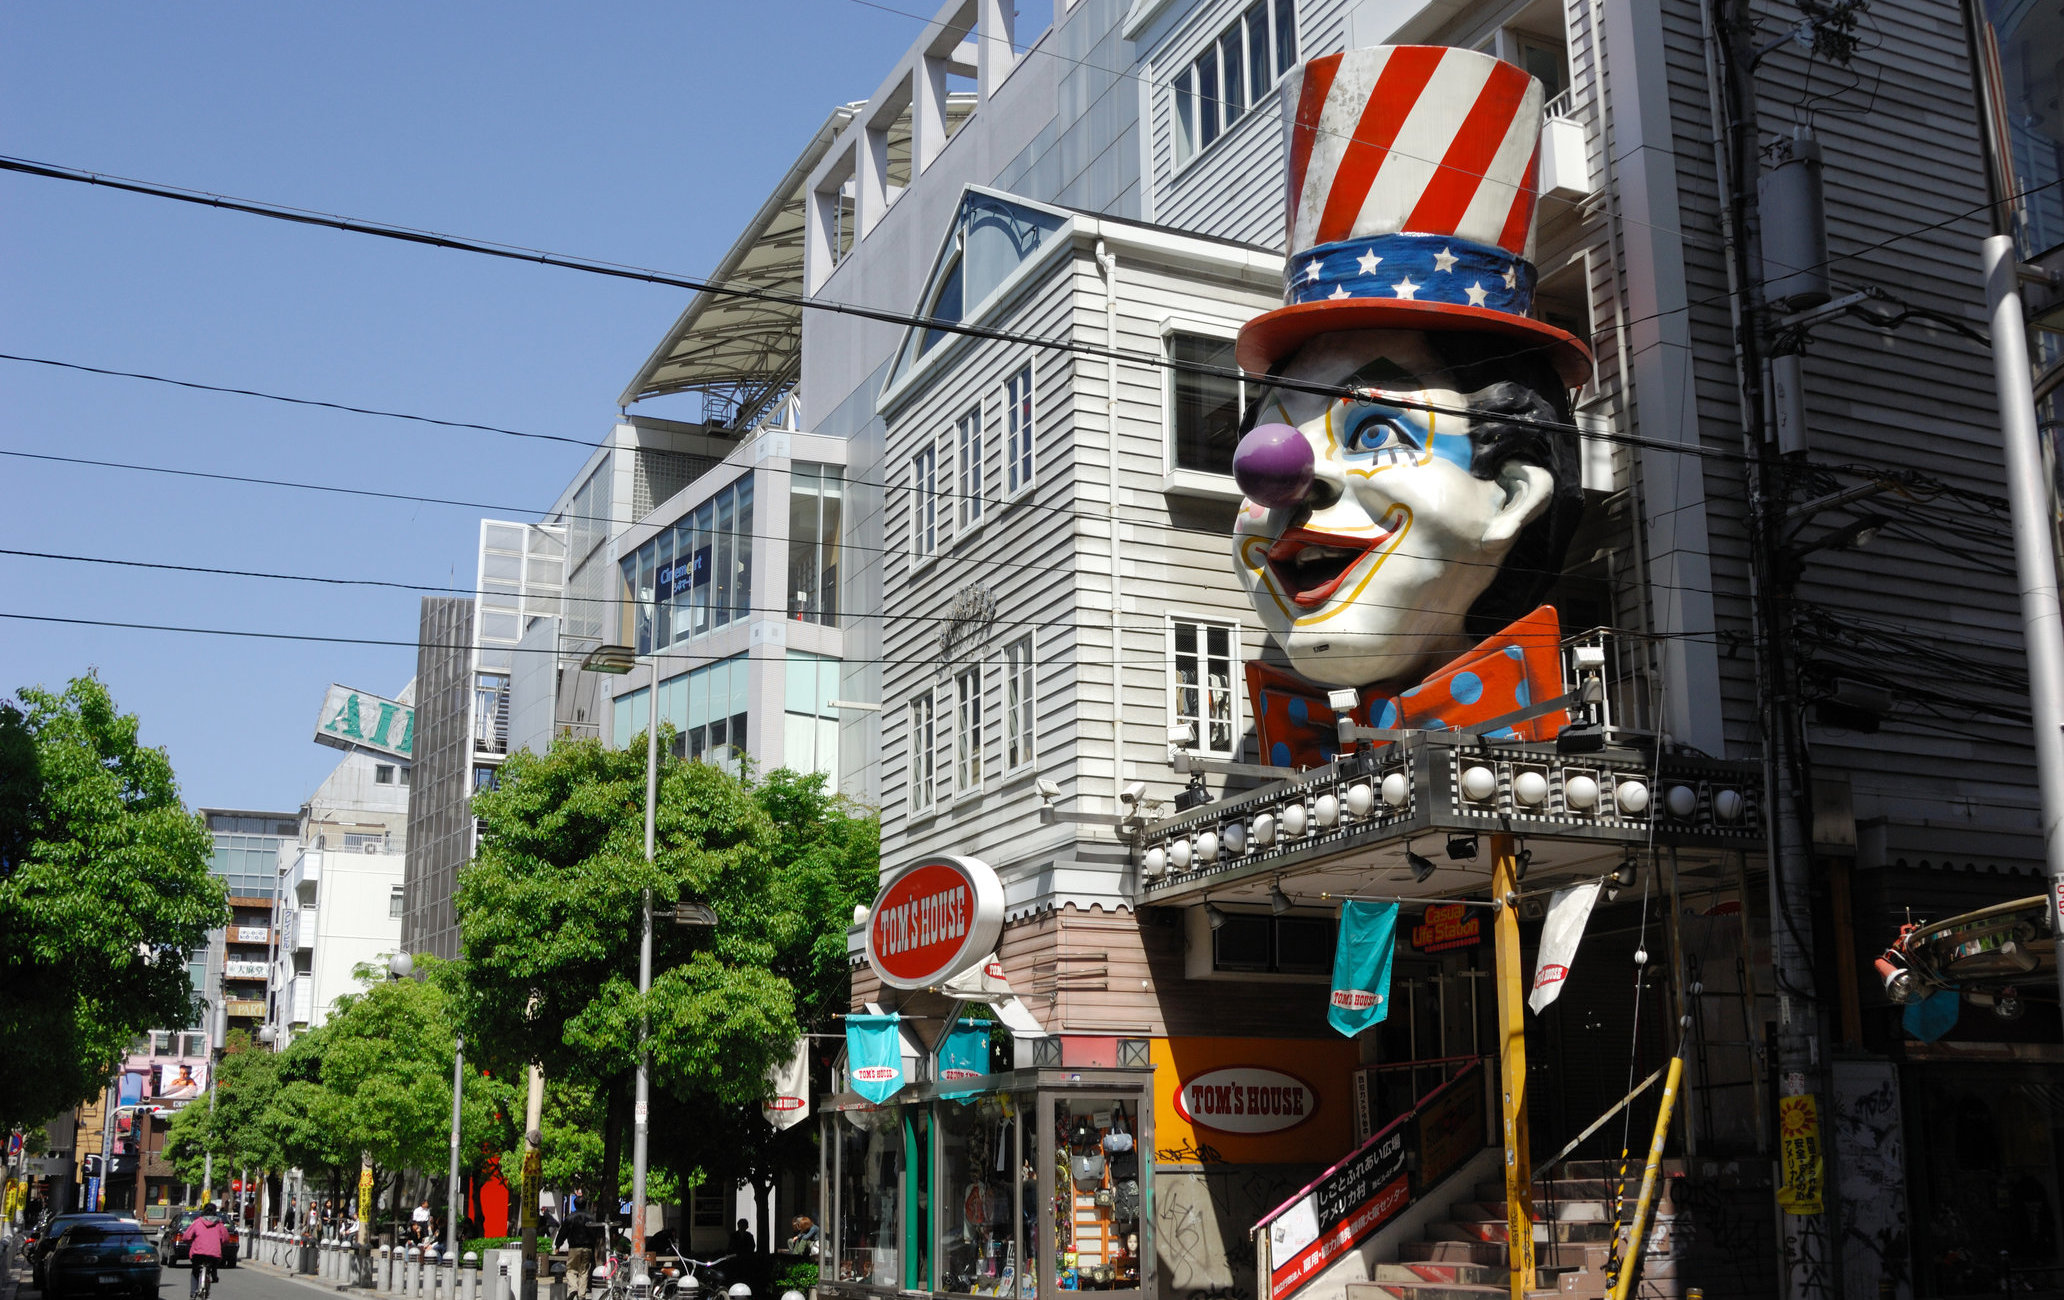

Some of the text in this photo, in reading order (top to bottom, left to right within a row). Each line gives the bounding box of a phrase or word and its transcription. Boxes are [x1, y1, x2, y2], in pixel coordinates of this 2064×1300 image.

[881, 885, 965, 957] TOM'S HOUSE
[1425, 899, 1467, 925] Casual
[1412, 925, 1434, 947] Life
[1434, 918, 1480, 942] Station
[859, 1068, 892, 1079] TOM'S HOUSE
[1192, 1081, 1303, 1115] TOM'S HOUSE
[1320, 1132, 1401, 1206] しごとふれあい広場
[1320, 1180, 1366, 1228] アメリカ村
